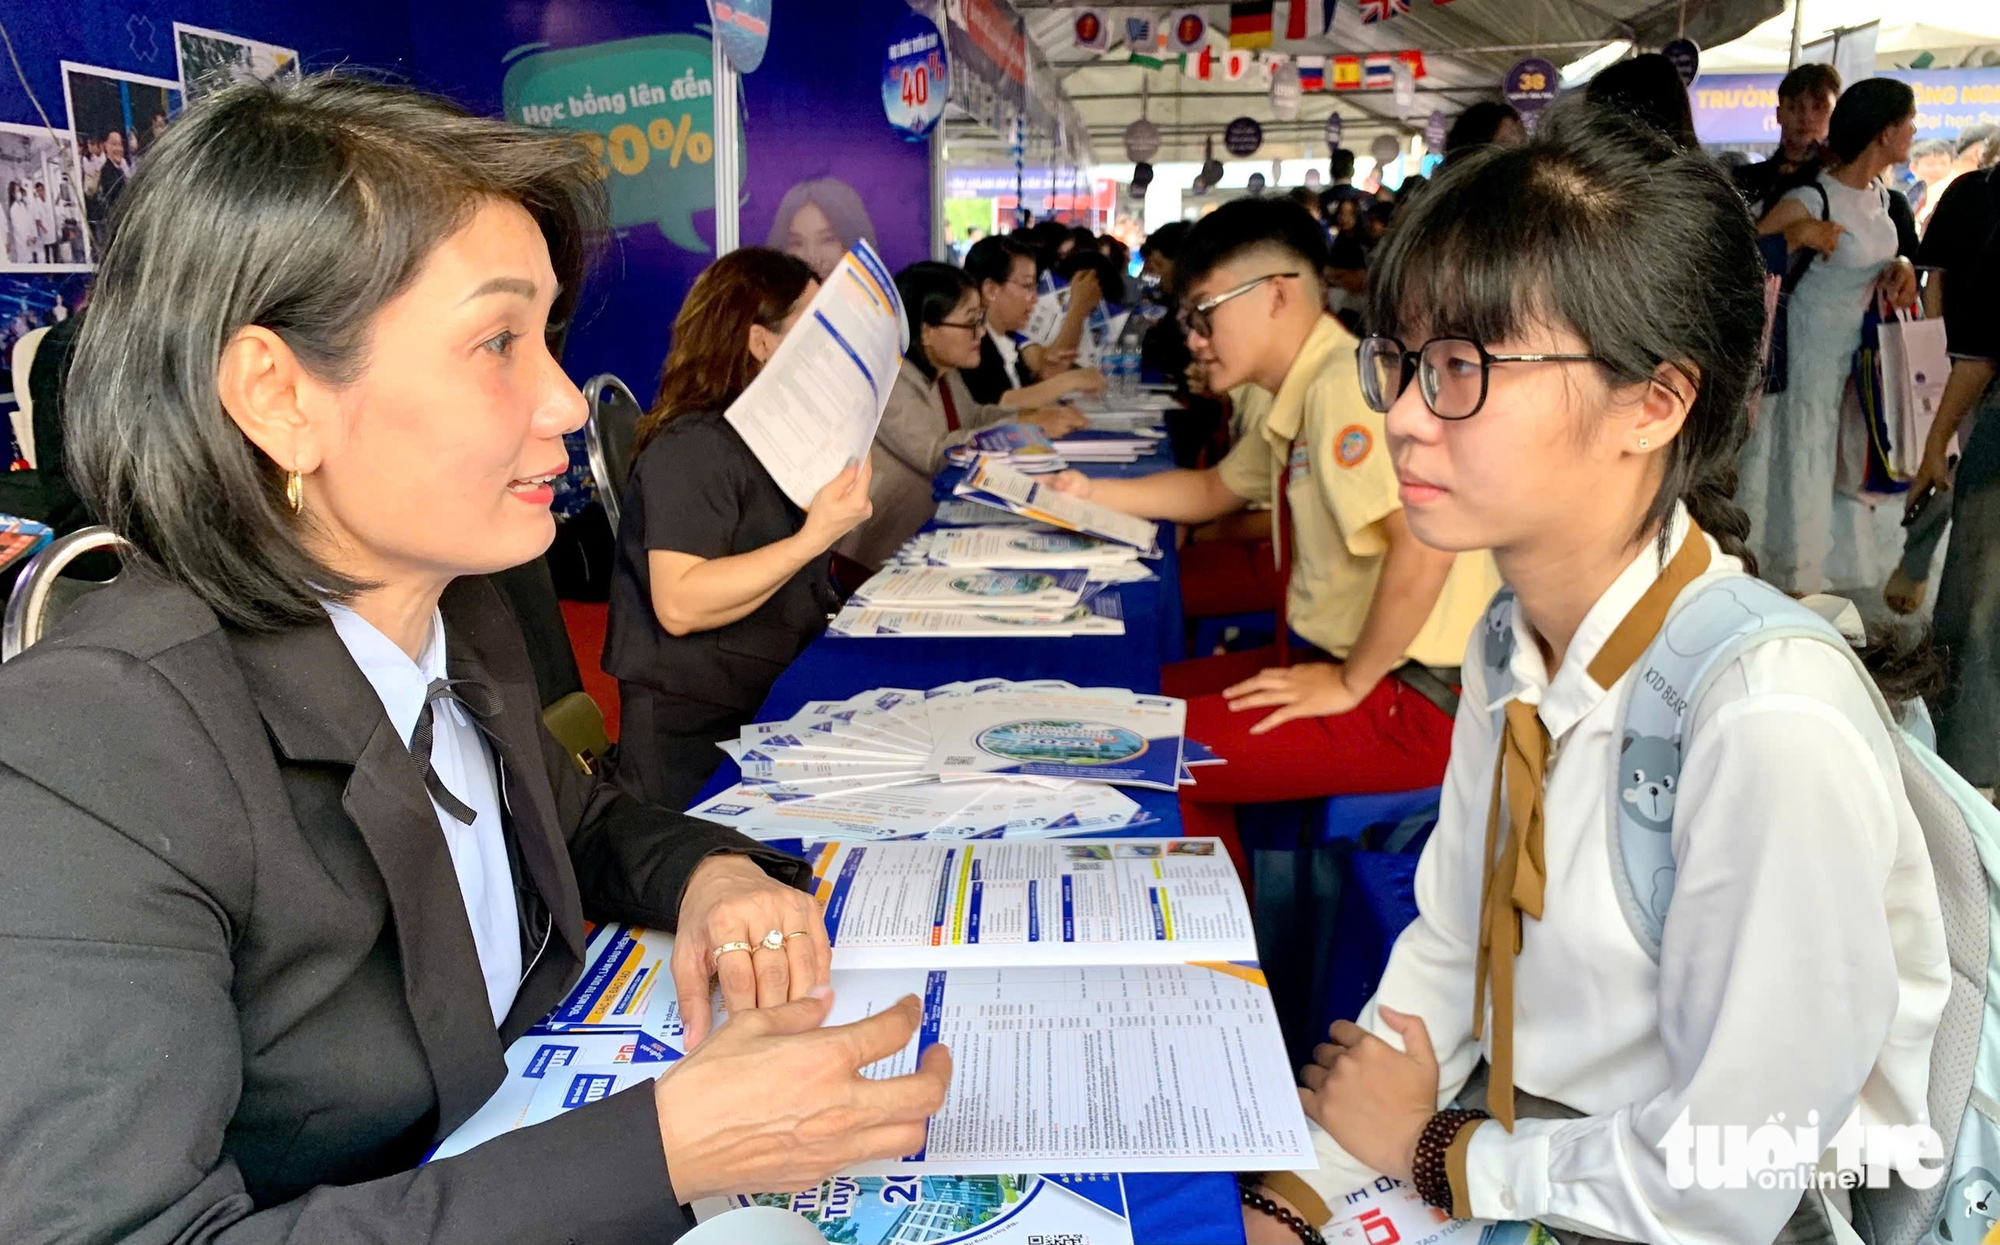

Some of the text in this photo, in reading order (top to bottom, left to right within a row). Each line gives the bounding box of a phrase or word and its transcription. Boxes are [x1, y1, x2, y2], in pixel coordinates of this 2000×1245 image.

[522, 102, 565, 126] Học
[569, 85, 626, 117] bổng
[629, 81, 665, 108] lên
[1697, 84, 1780, 109] TRƯỜN
[1912, 82, 1957, 105] ÔNG
[1643, 667, 1687, 717] KID BEAR
